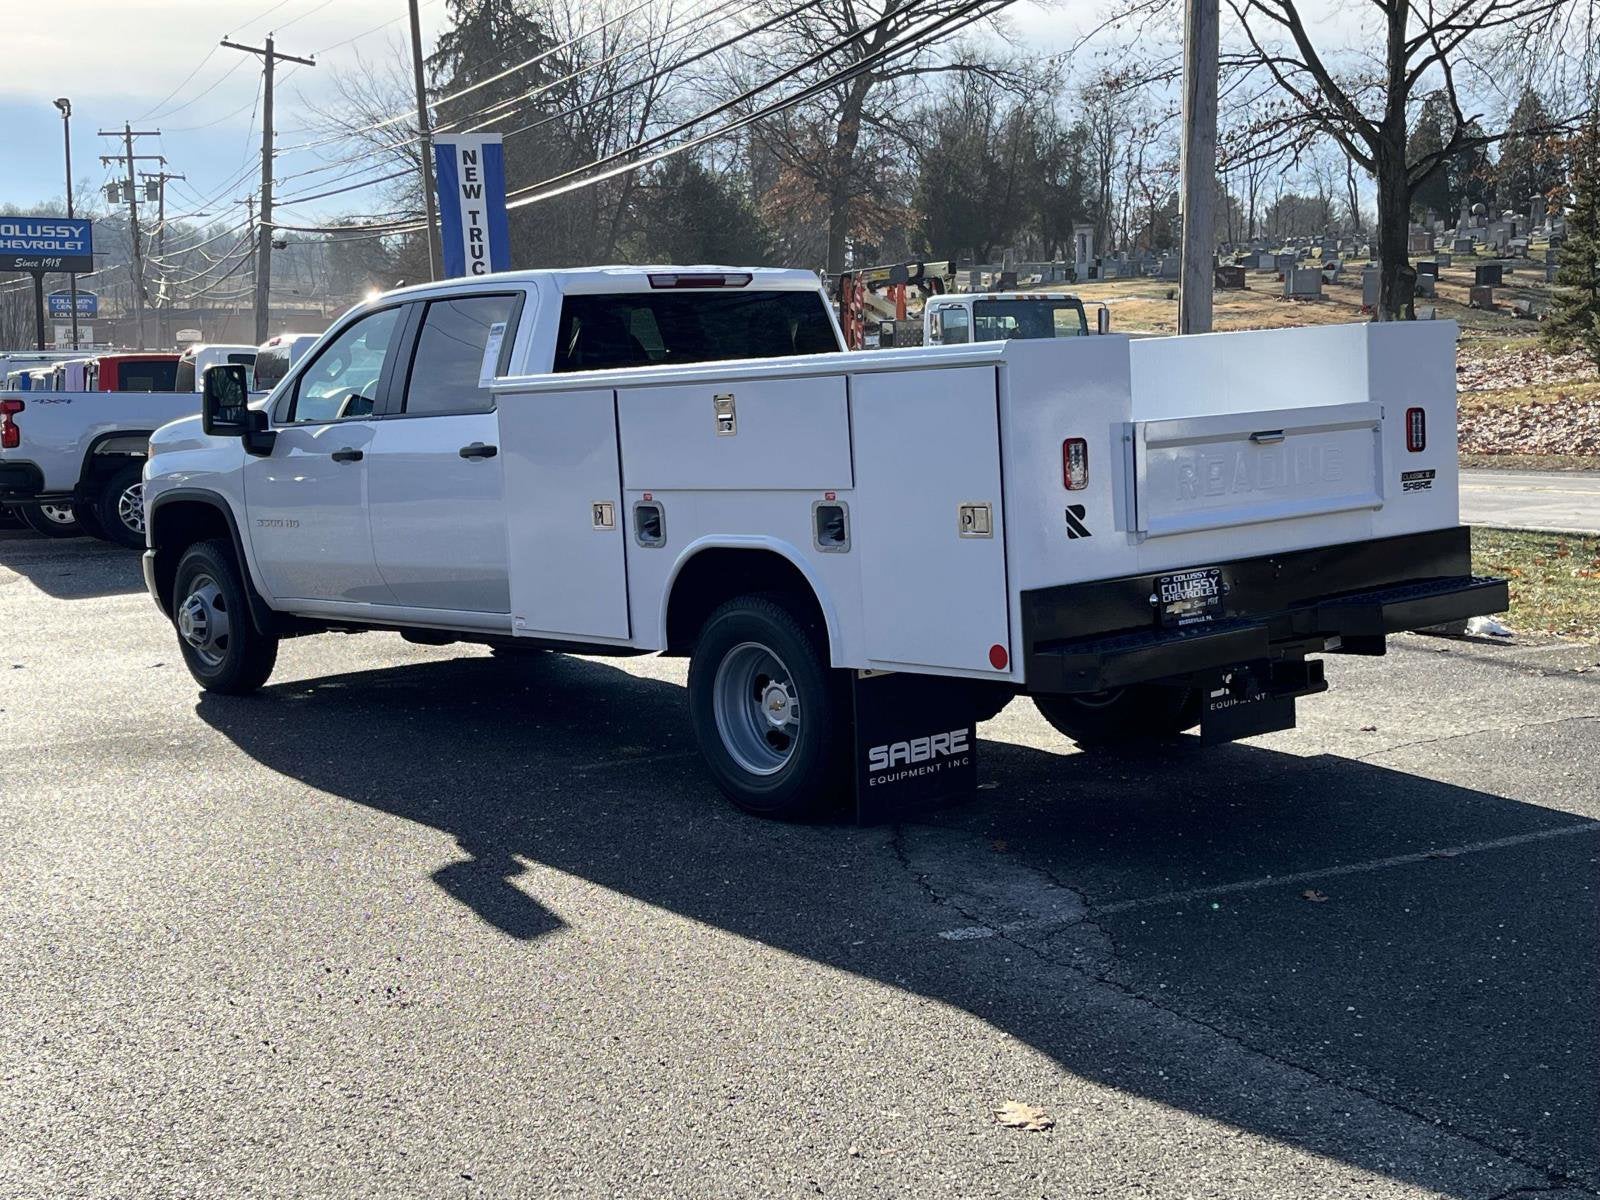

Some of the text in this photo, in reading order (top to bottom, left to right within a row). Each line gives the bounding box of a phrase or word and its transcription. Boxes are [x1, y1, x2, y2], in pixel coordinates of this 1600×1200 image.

[462, 150, 485, 276] NEW TRUC
[0, 224, 84, 238] OLUSSY
[0, 240, 84, 250] HEVROLET
[14, 257, 61, 268] Since 1918
[1176, 447, 1344, 500] READING
[1402, 480, 1432, 491] SABRE
[1173, 571, 1207, 582] COLUSSY
[1161, 577, 1218, 595] COLUSSY
[1162, 586, 1219, 602] CHEVROLET
[868, 728, 969, 772] SABRE
[869, 757, 969, 786] EQUIPMENT INC
